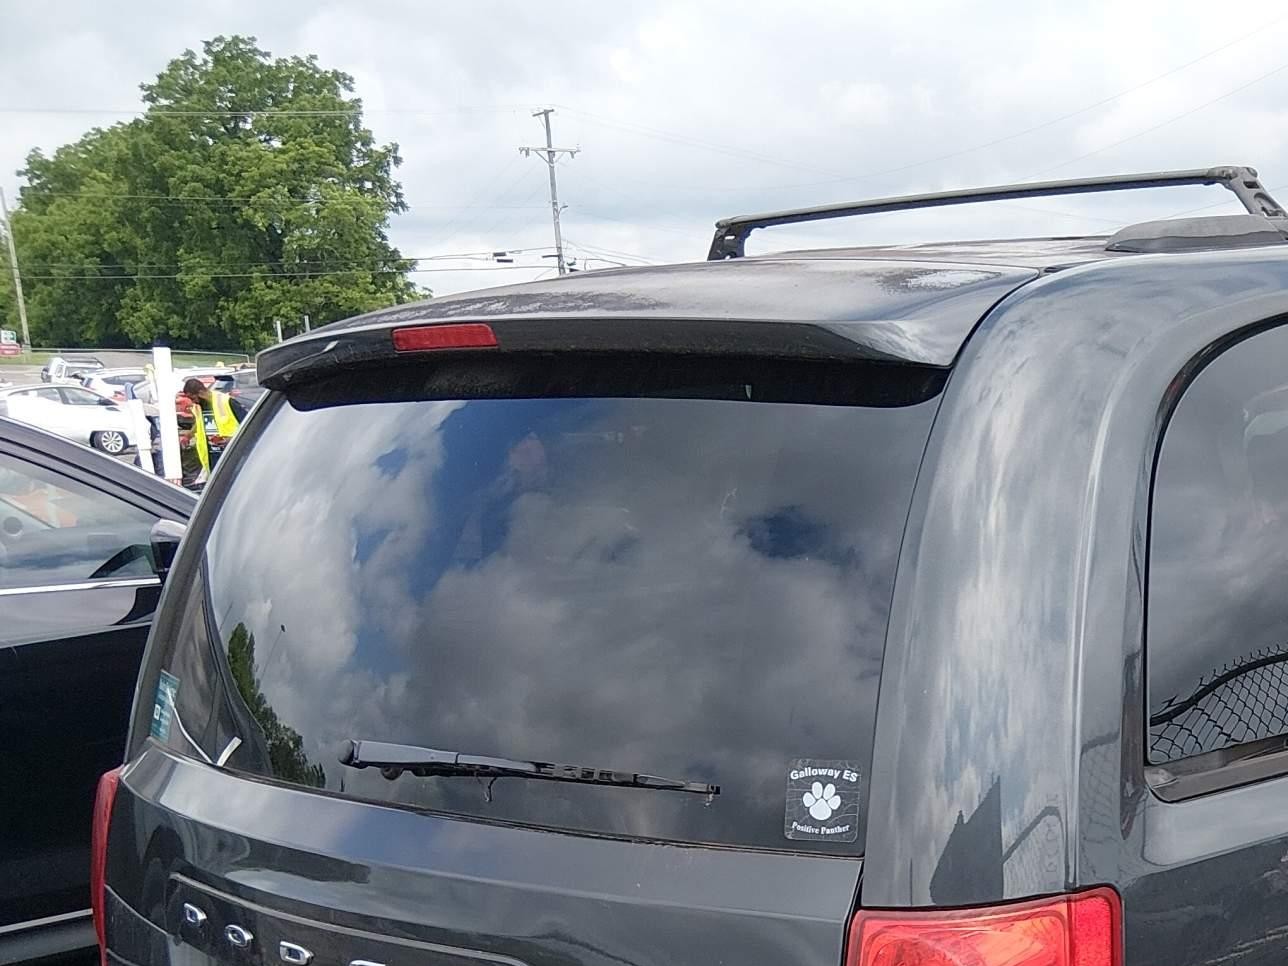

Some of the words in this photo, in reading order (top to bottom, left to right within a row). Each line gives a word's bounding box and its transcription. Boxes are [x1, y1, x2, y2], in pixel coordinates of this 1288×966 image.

[790, 767, 841, 780] Galloway
[842, 769, 858, 782] ES
[792, 821, 820, 834] Positive
[821, 824, 850, 835] Panther
